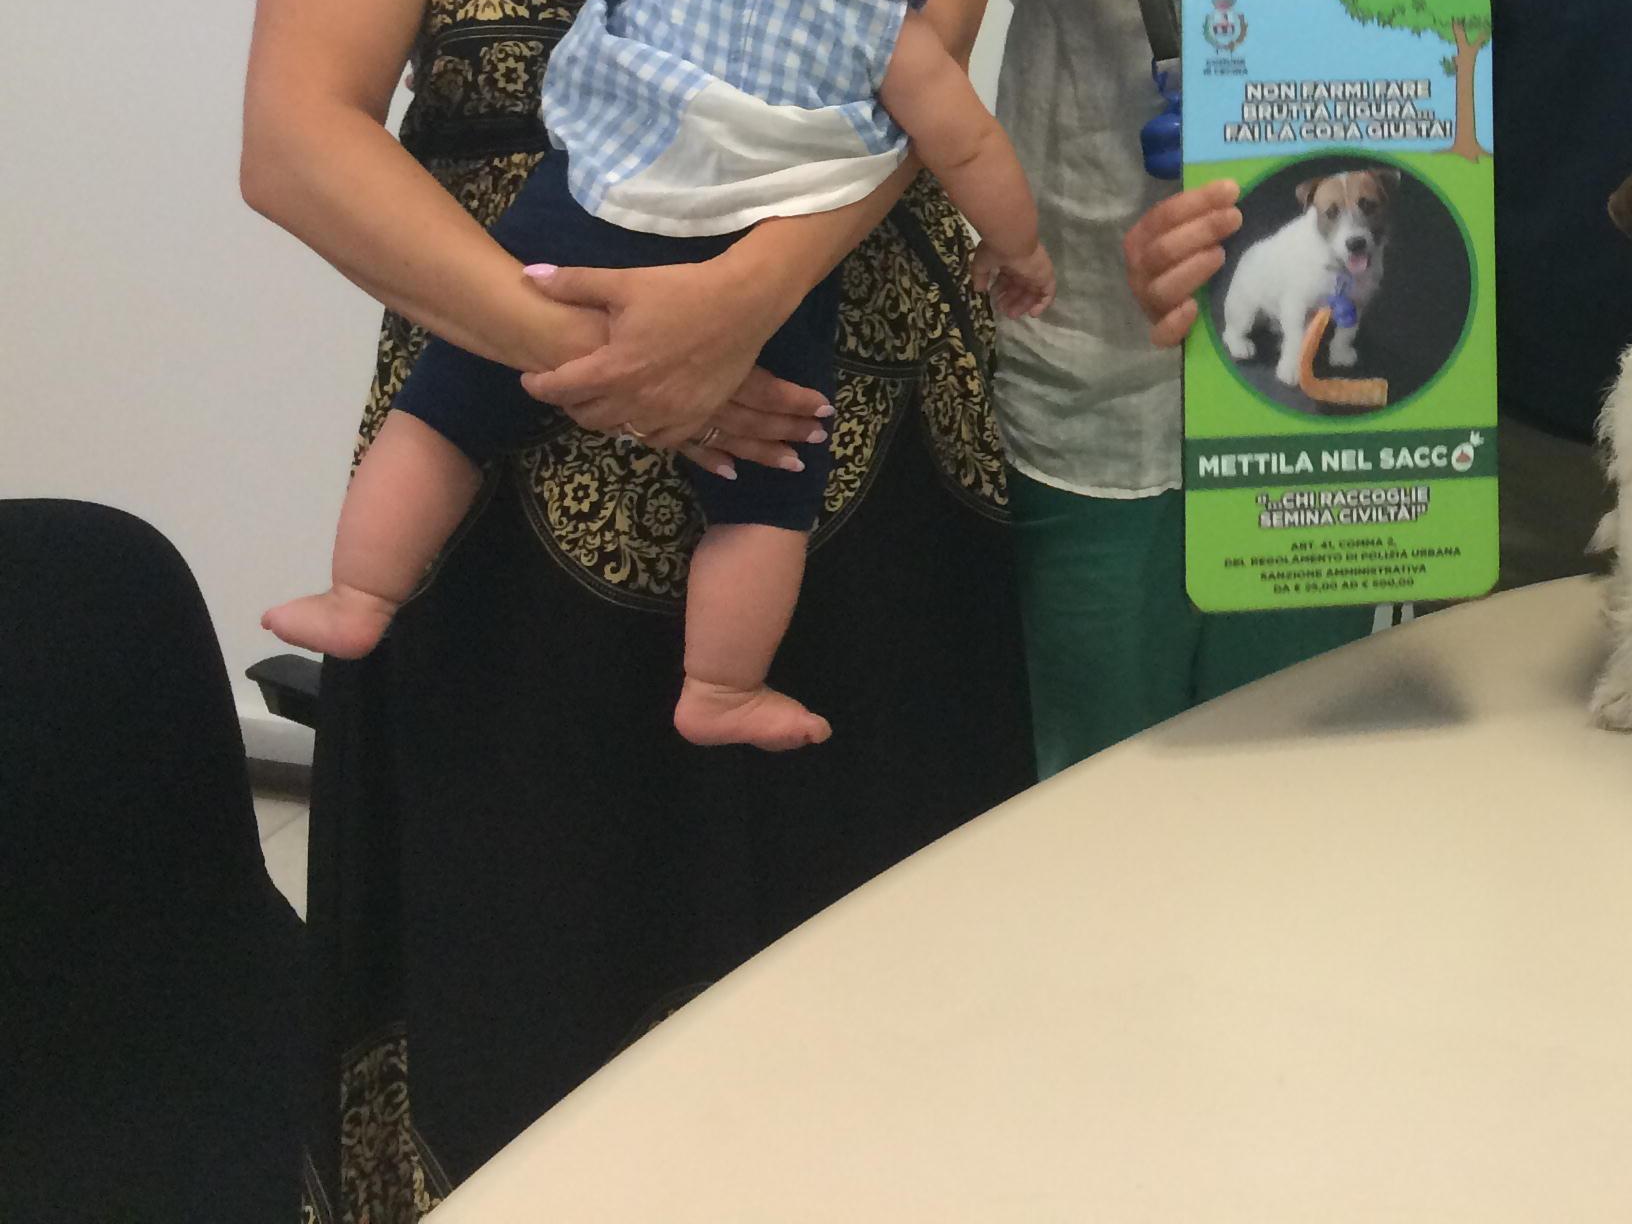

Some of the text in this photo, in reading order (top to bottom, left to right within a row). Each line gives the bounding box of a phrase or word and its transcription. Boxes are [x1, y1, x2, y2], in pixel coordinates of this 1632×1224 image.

[1245, 79, 1431, 101] NON FARMI FARE
[1242, 101, 1332, 122] BRUTTA
[1224, 119, 1453, 144] FAI LA COSA GIUSTA!
[1199, 450, 1314, 477] METTILA
[1321, 448, 1373, 472] NEL
[1320, 485, 1431, 509] RACCOGLIE
[1259, 508, 1336, 528] SEMINA
[1339, 537, 1383, 549] COMMA
[1224, 546, 1462, 568] DEL REGOLAMENTO DI POLIZIA URBANA
[1260, 563, 1426, 581] SANZIONE AMMINISTRATIVA
